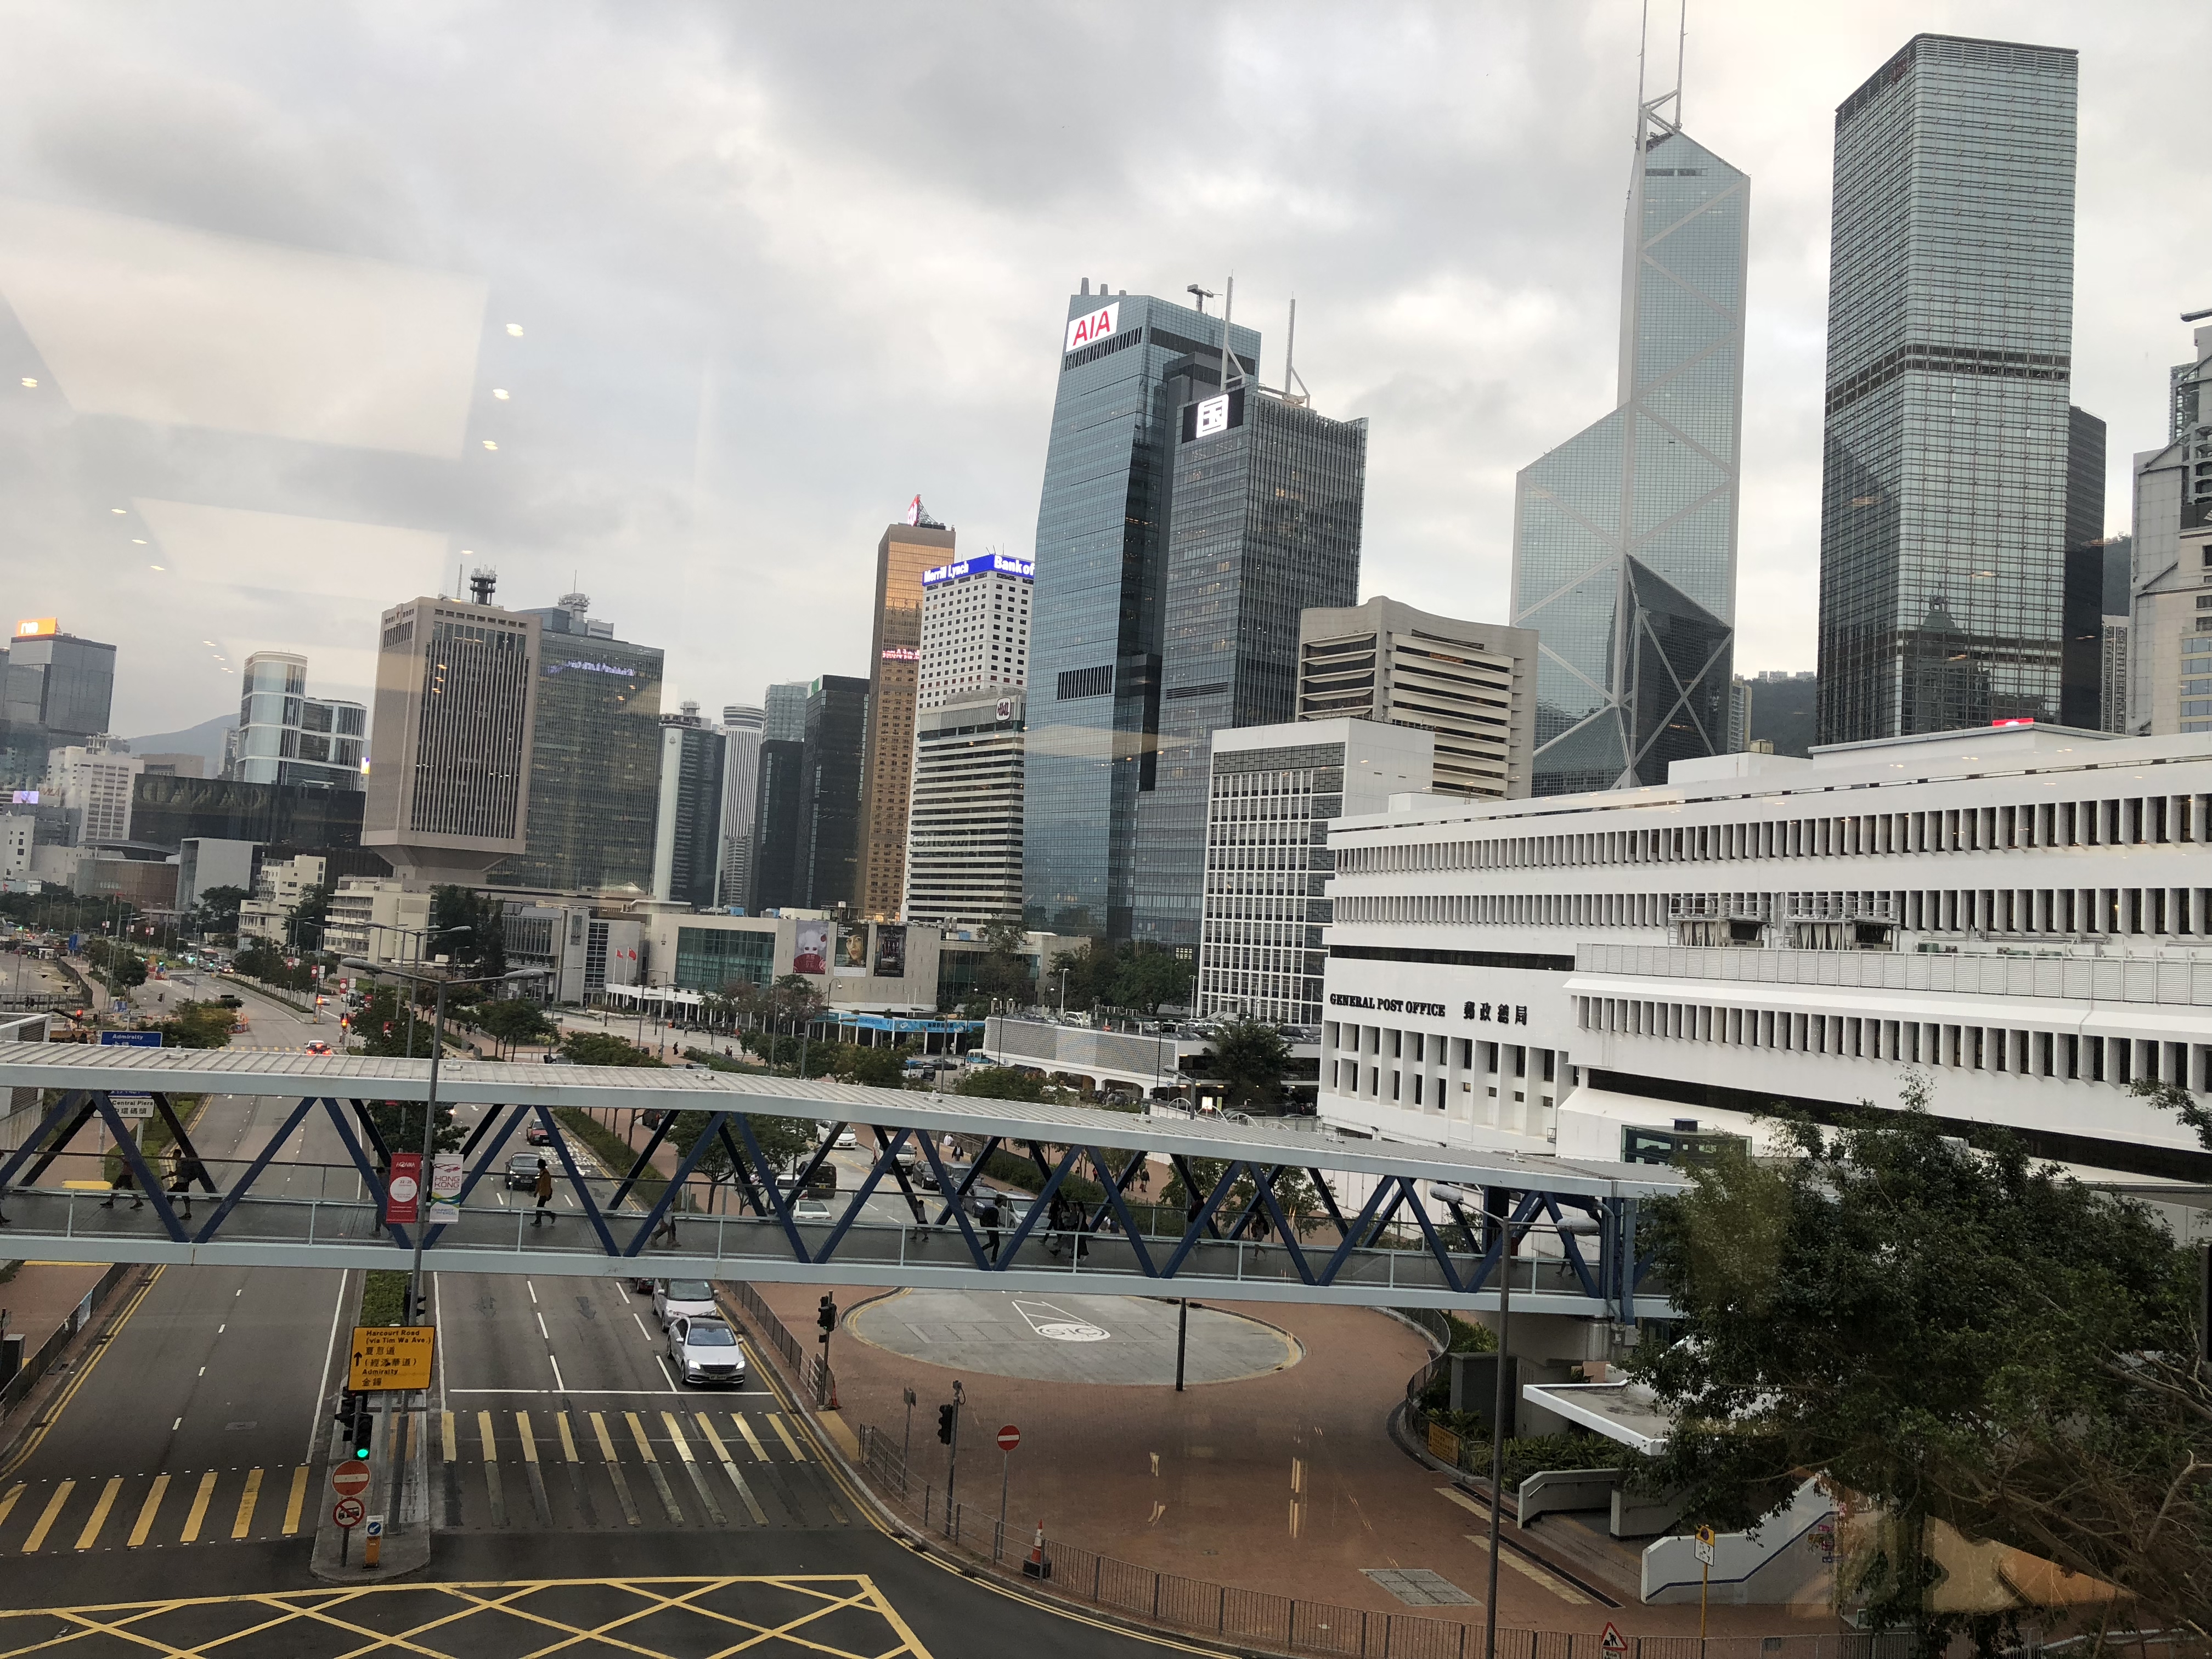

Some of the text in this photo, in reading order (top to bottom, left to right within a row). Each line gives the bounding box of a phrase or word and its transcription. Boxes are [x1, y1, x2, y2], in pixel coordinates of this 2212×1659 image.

[1073, 311, 1110, 346] AIA
[924, 561, 969, 583] Merrill Lynch
[994, 555, 1035, 576] Bank of
[1330, 993, 1446, 1017] GENERAL POST OFFICE
